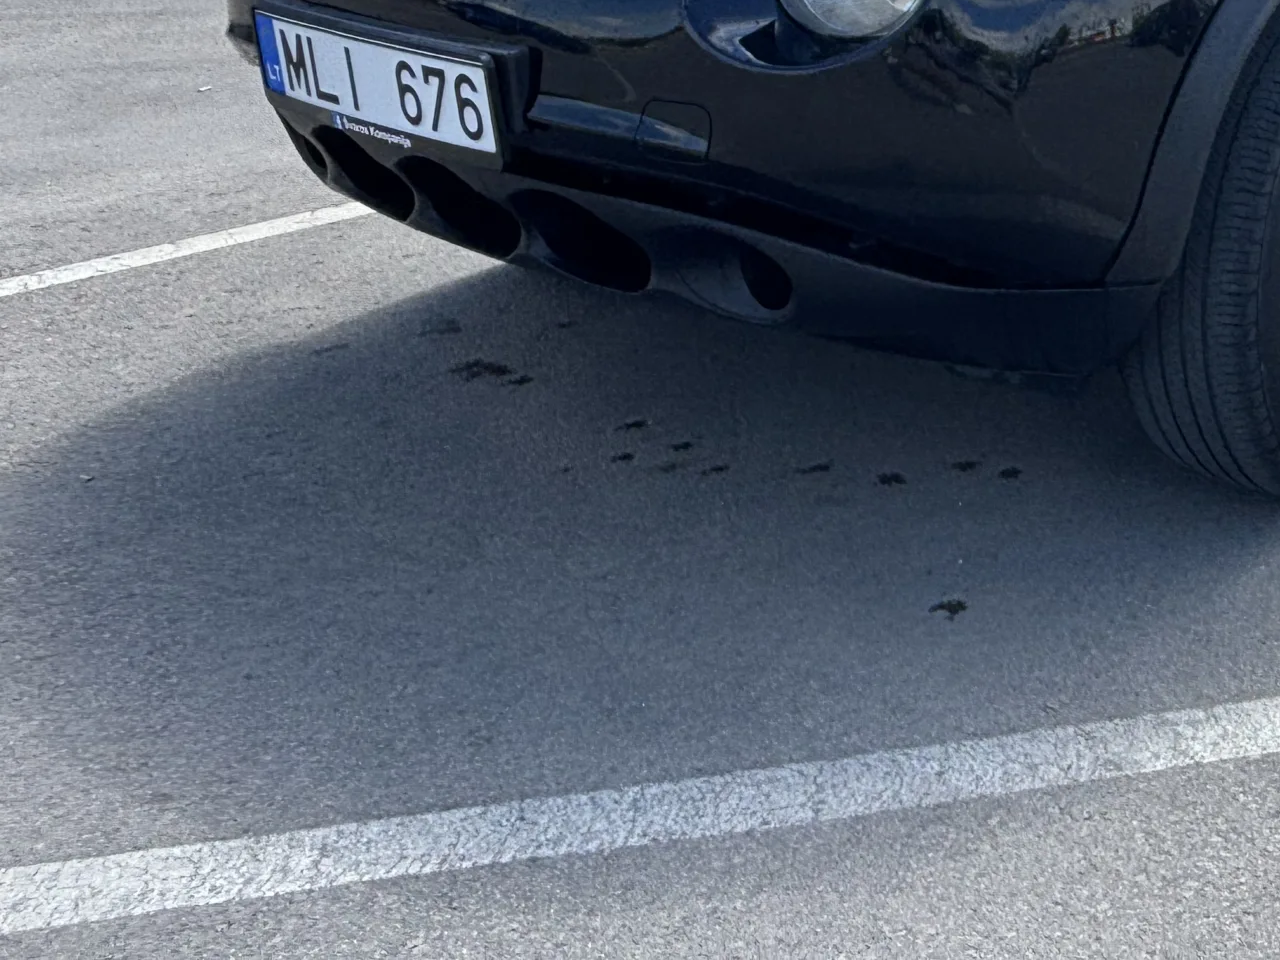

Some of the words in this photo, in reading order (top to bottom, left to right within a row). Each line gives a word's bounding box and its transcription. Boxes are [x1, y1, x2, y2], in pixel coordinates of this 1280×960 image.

[266, 61, 282, 82] LT
[279, 29, 360, 111] MLI
[395, 60, 484, 141] 676
